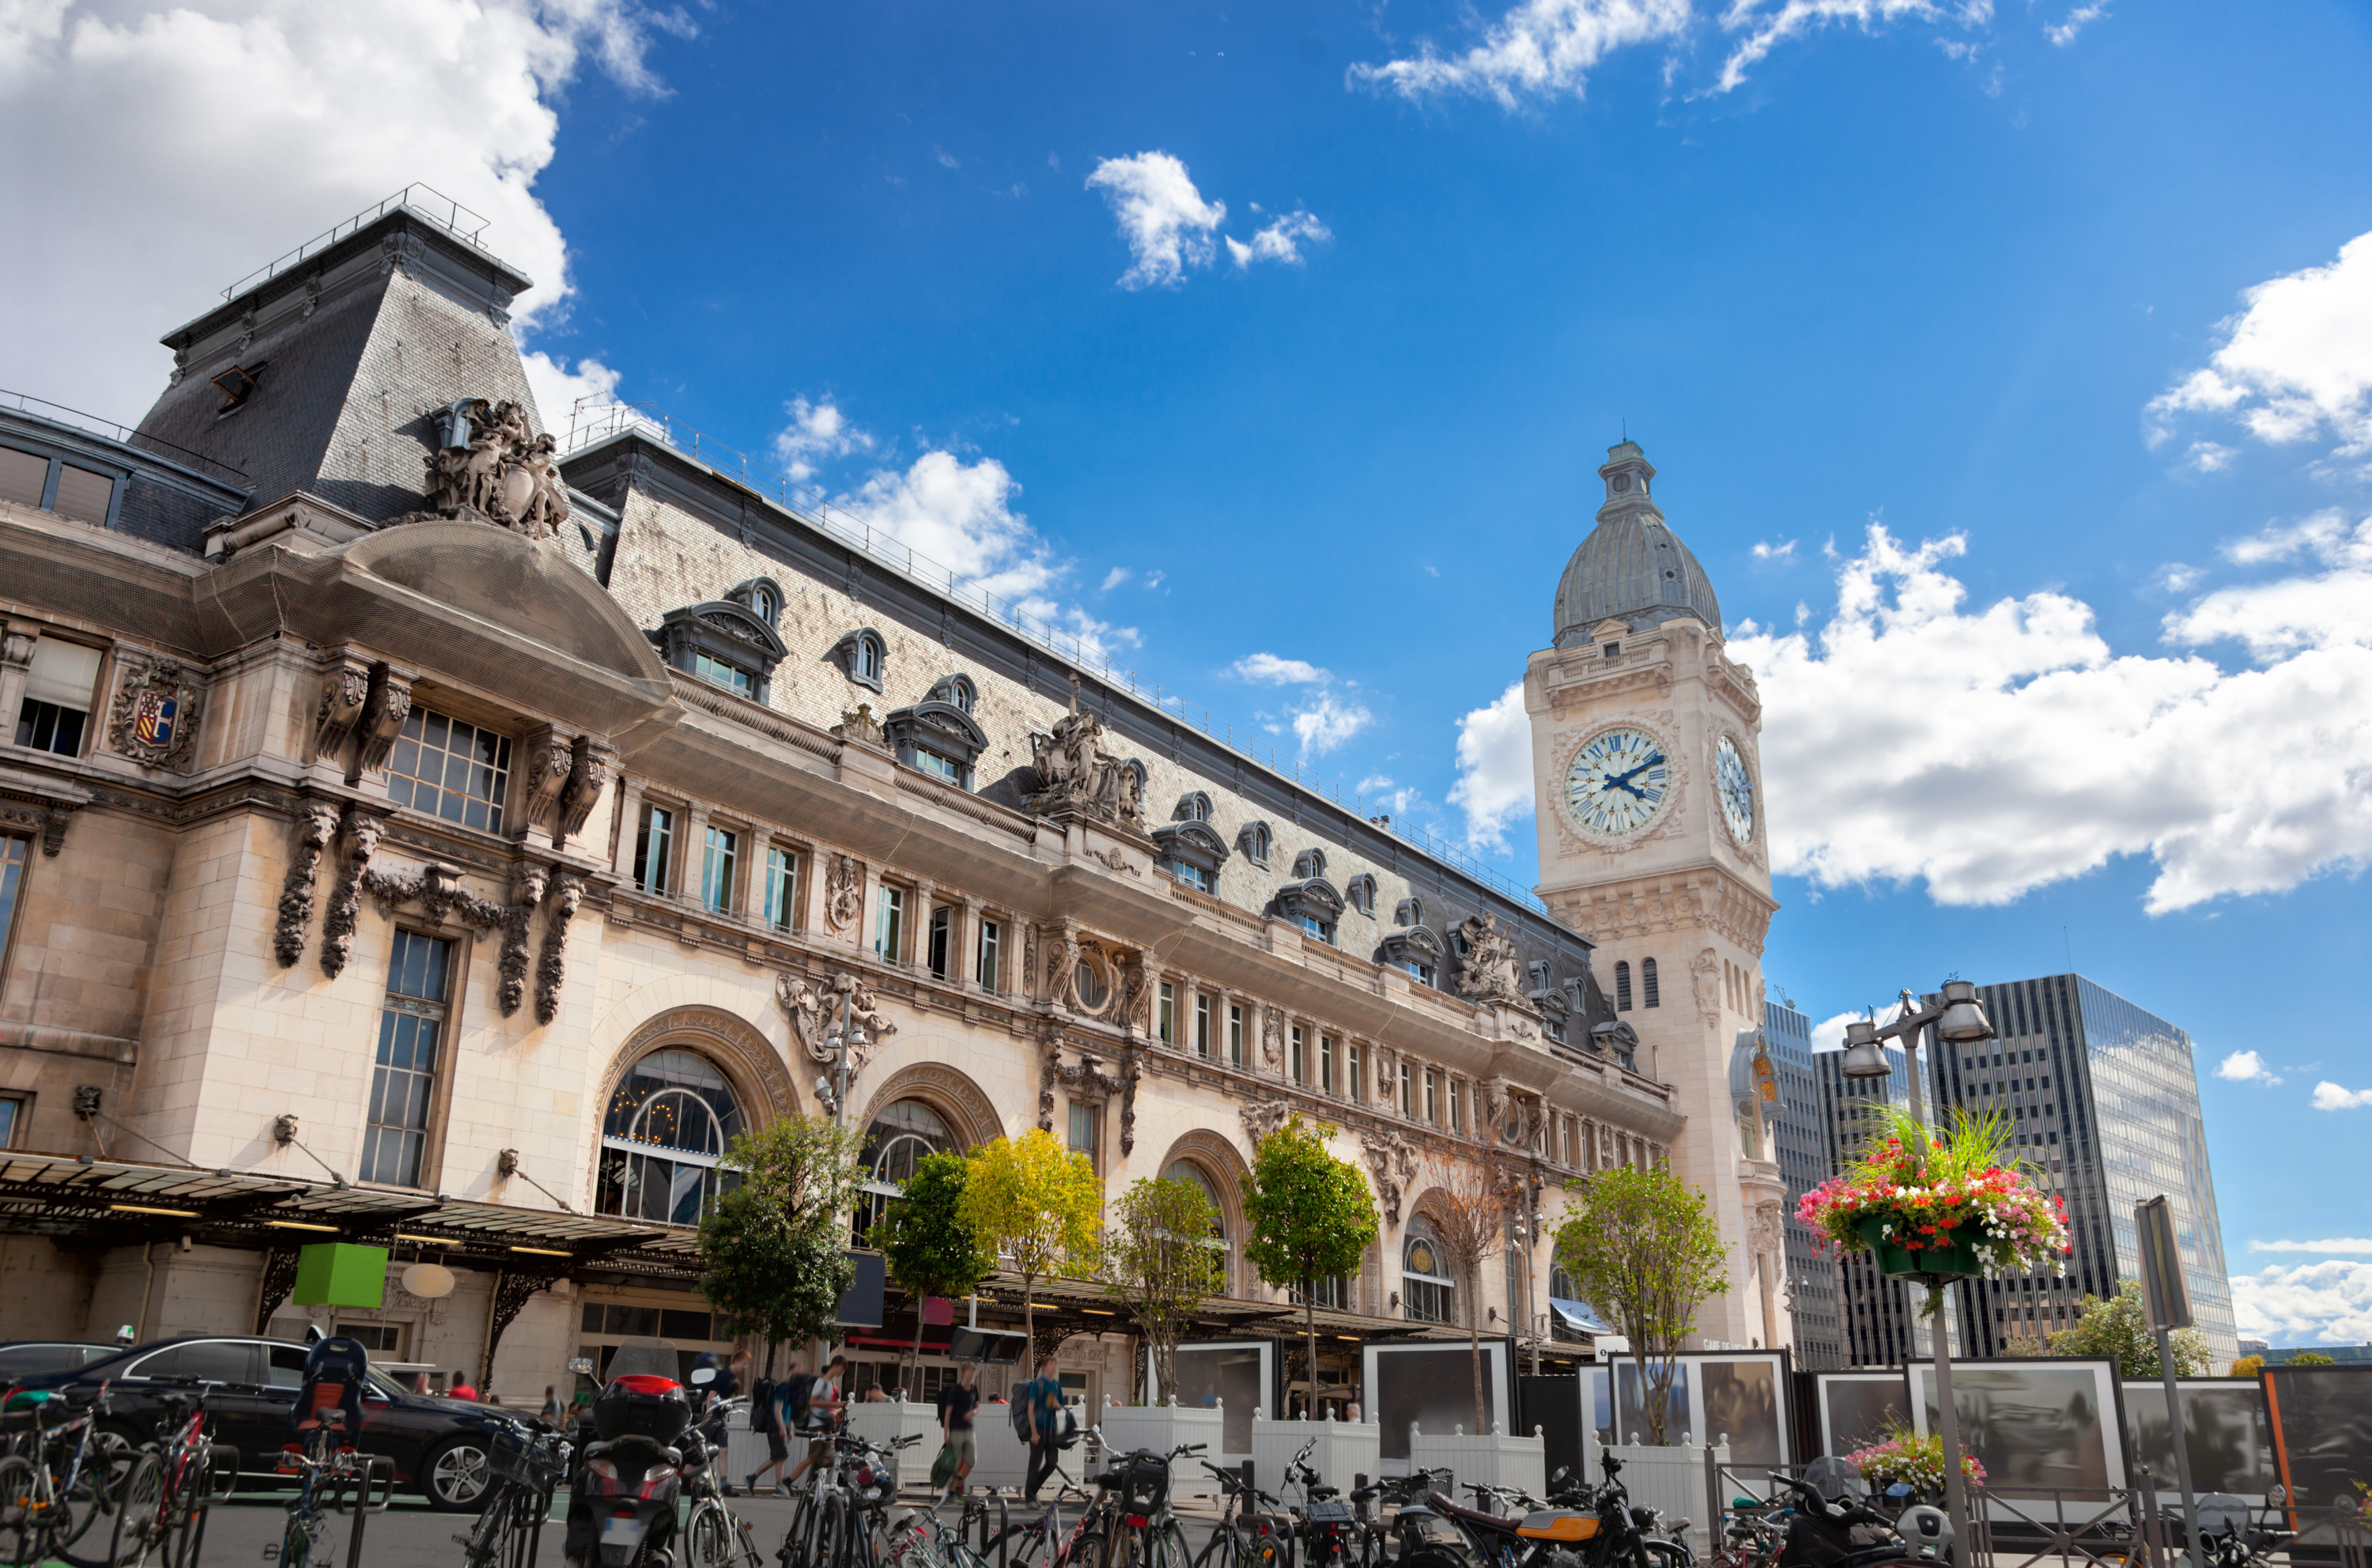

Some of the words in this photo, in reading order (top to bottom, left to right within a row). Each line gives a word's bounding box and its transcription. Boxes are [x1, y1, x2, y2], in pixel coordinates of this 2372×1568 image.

[1608, 735, 1621, 753] XII
[1630, 737, 1640, 753] I
[1588, 744, 1603, 761] XI
[1575, 764, 1591, 774] X
[1649, 769, 1666, 780] III
[1571, 784, 1587, 795] IX
[1634, 806, 1647, 821] V
